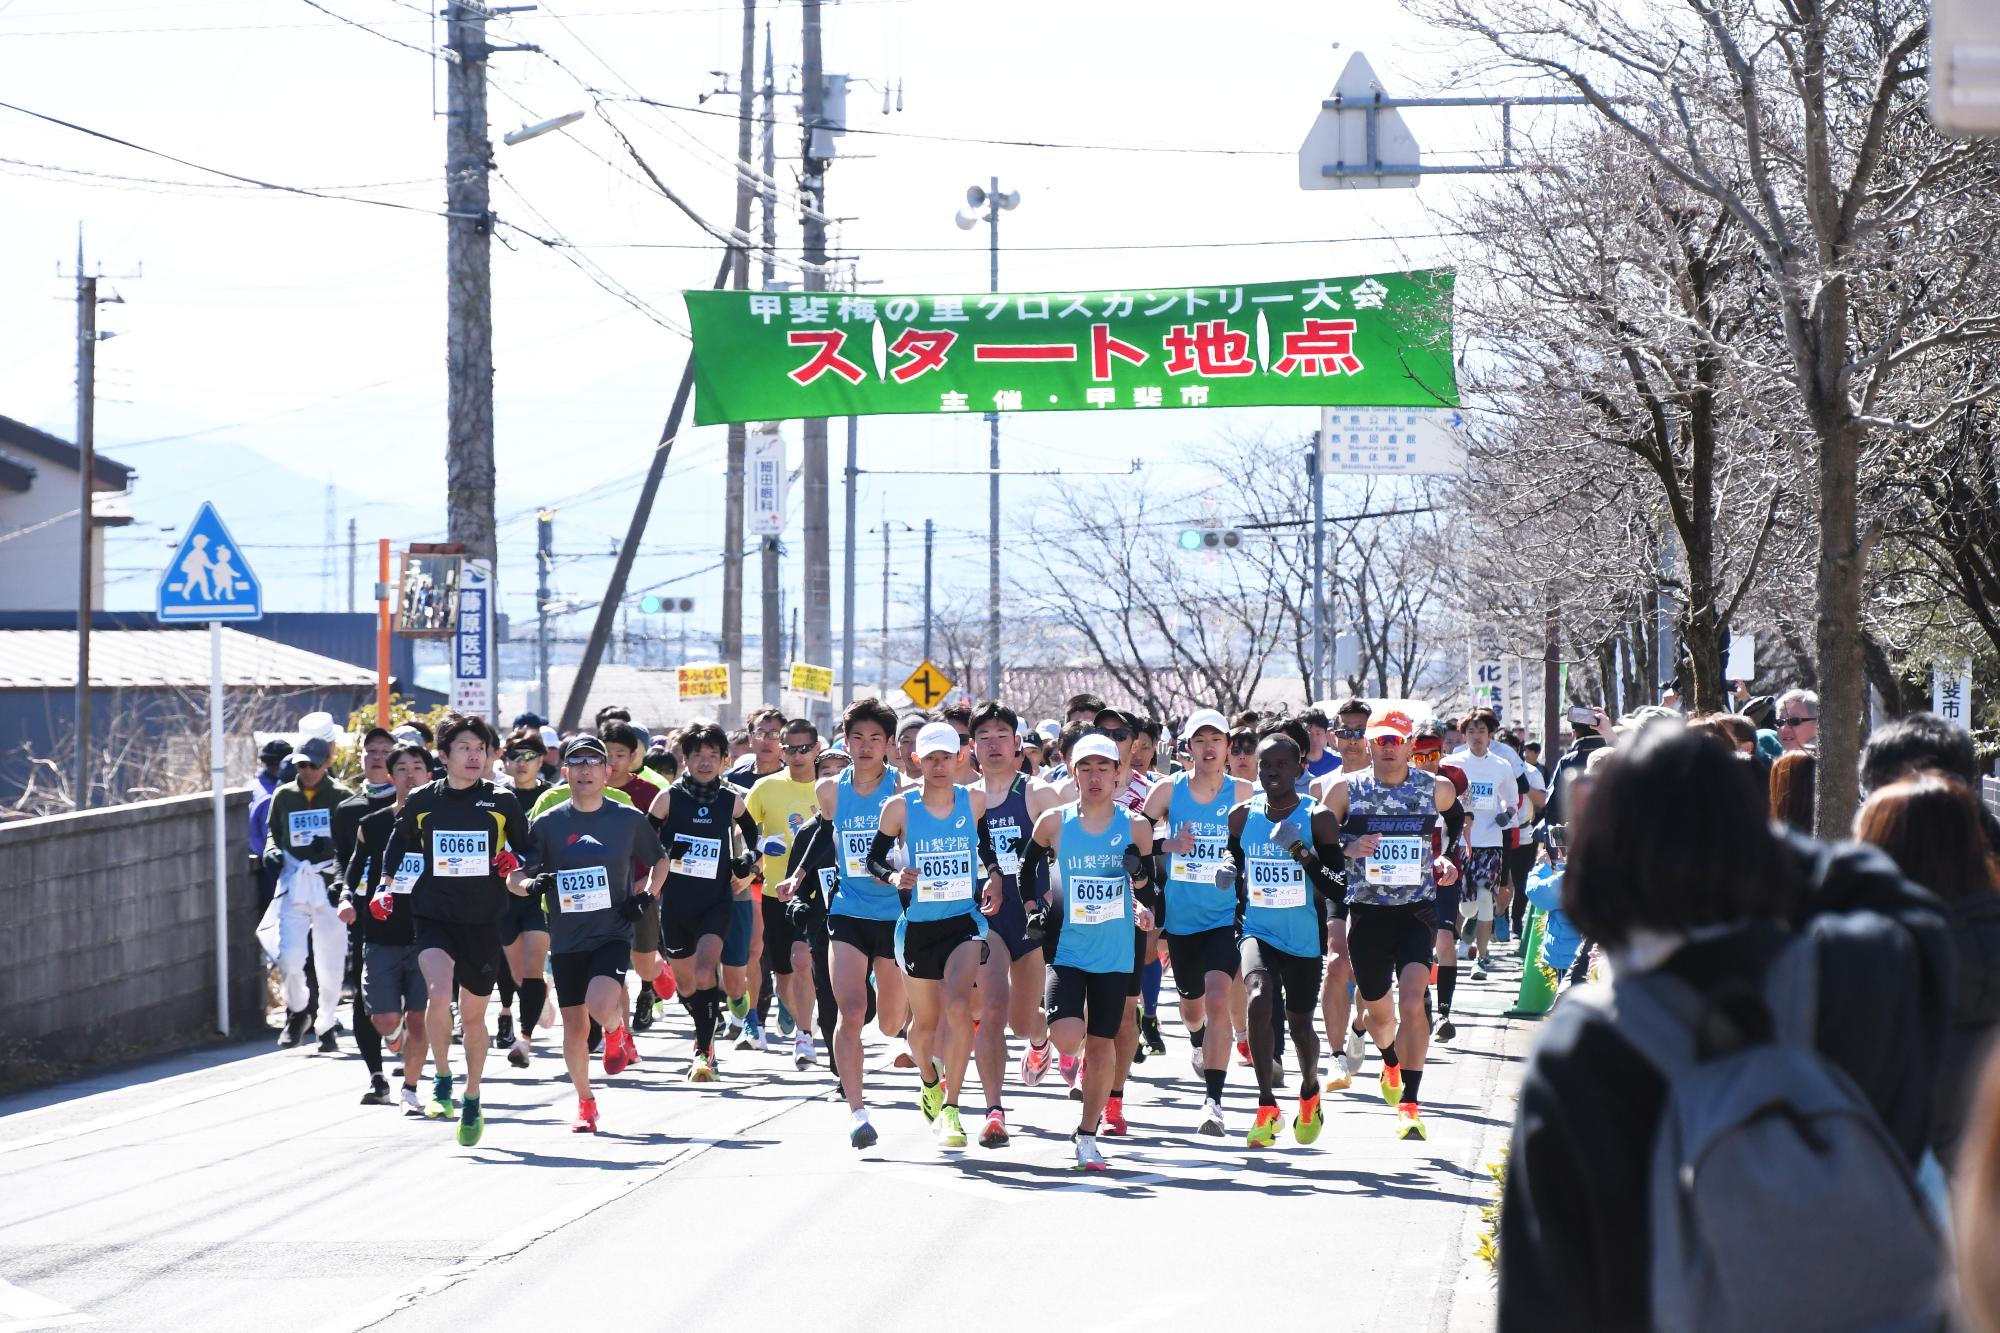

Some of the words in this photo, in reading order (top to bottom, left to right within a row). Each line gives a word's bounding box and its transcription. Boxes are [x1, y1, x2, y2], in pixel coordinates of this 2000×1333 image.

[749, 278, 1389, 325] 甲斐梅の里クロスカントリー大会
[787, 318, 1365, 387] スタート地点
[939, 385, 1210, 411] 主催・甲斐市
[440, 838, 475, 853] 6066
[915, 836, 970, 853] 山梨学院
[1180, 844, 1215, 860] 064
[1373, 844, 1408, 861] 6063
[923, 859, 959, 877] 6053
[1068, 854, 1124, 869] 山梨学院
[562, 875, 595, 891] 6229
[1255, 866, 1290, 883] 6055
[1077, 884, 1113, 900] 6054
